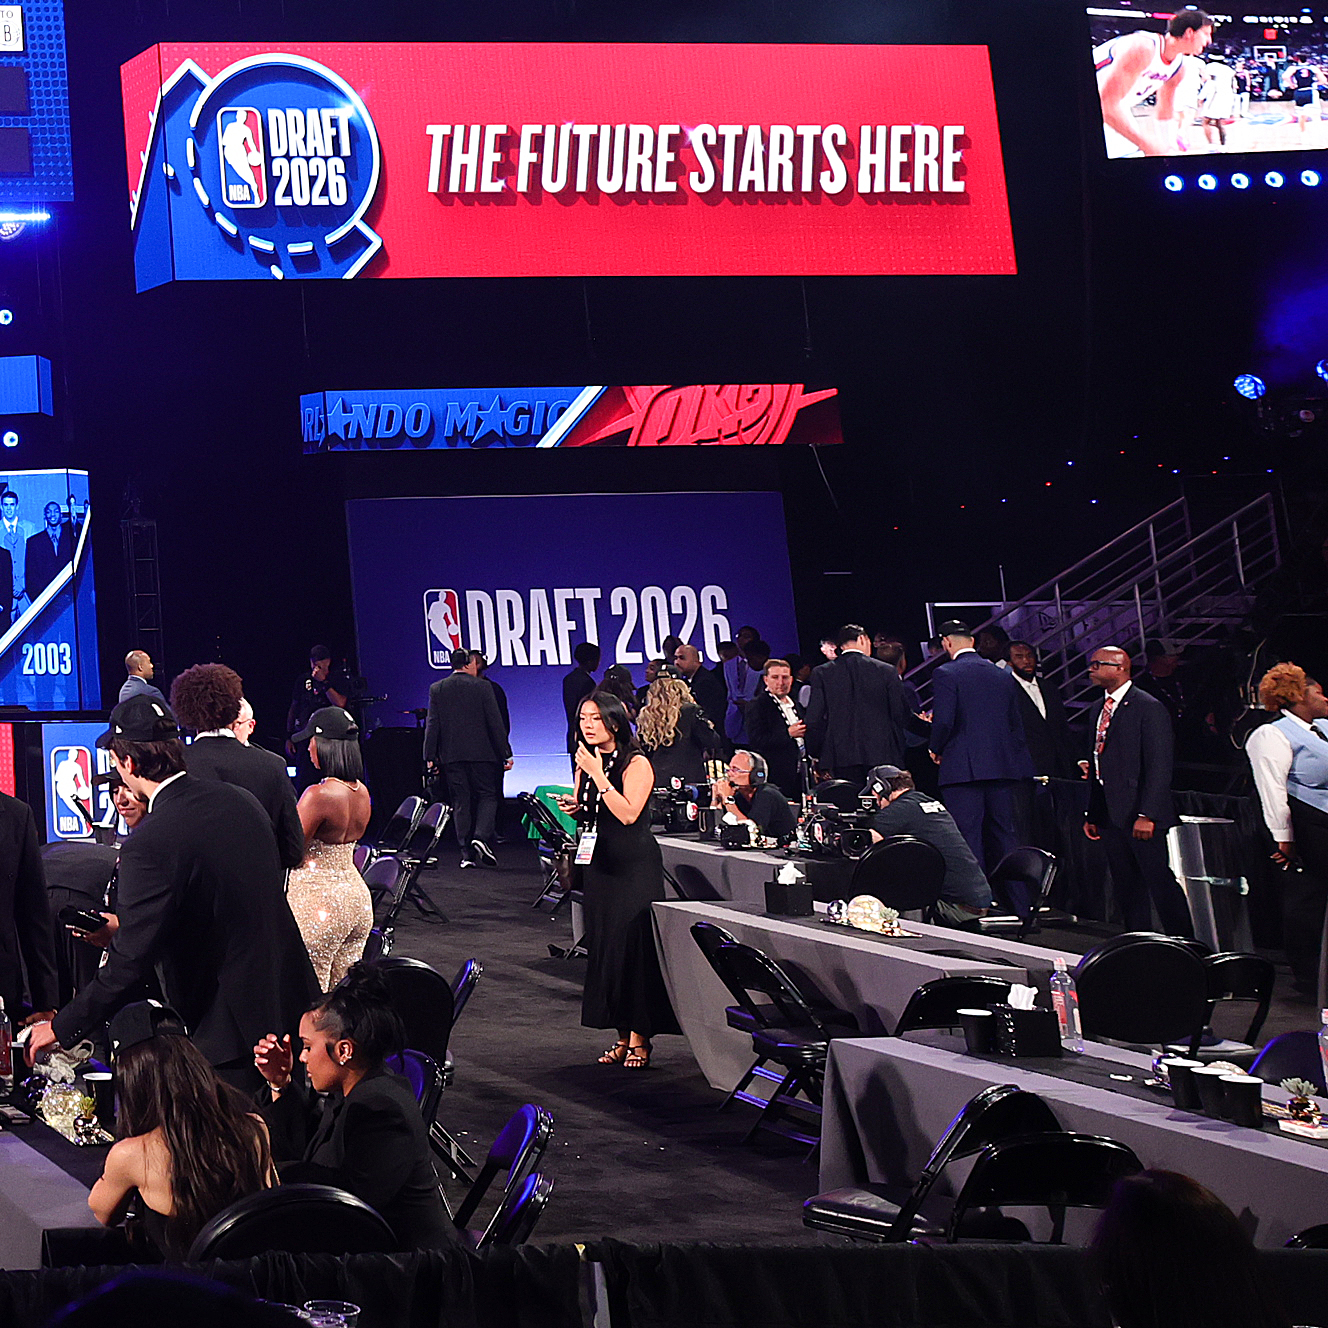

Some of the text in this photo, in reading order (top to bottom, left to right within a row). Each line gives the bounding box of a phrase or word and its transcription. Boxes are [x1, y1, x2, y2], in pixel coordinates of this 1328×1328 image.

[0, 10, 13, 19] TO
[267, 106, 355, 157] DRAFT
[425, 123, 967, 195] THE FUTURE STARTS HERE
[228, 184, 252, 202] NBA
[271, 156, 348, 207] 2026
[465, 585, 732, 666] DRAFT 2026
[22, 642, 72, 675] 2003
[59, 816, 80, 832] NBA
